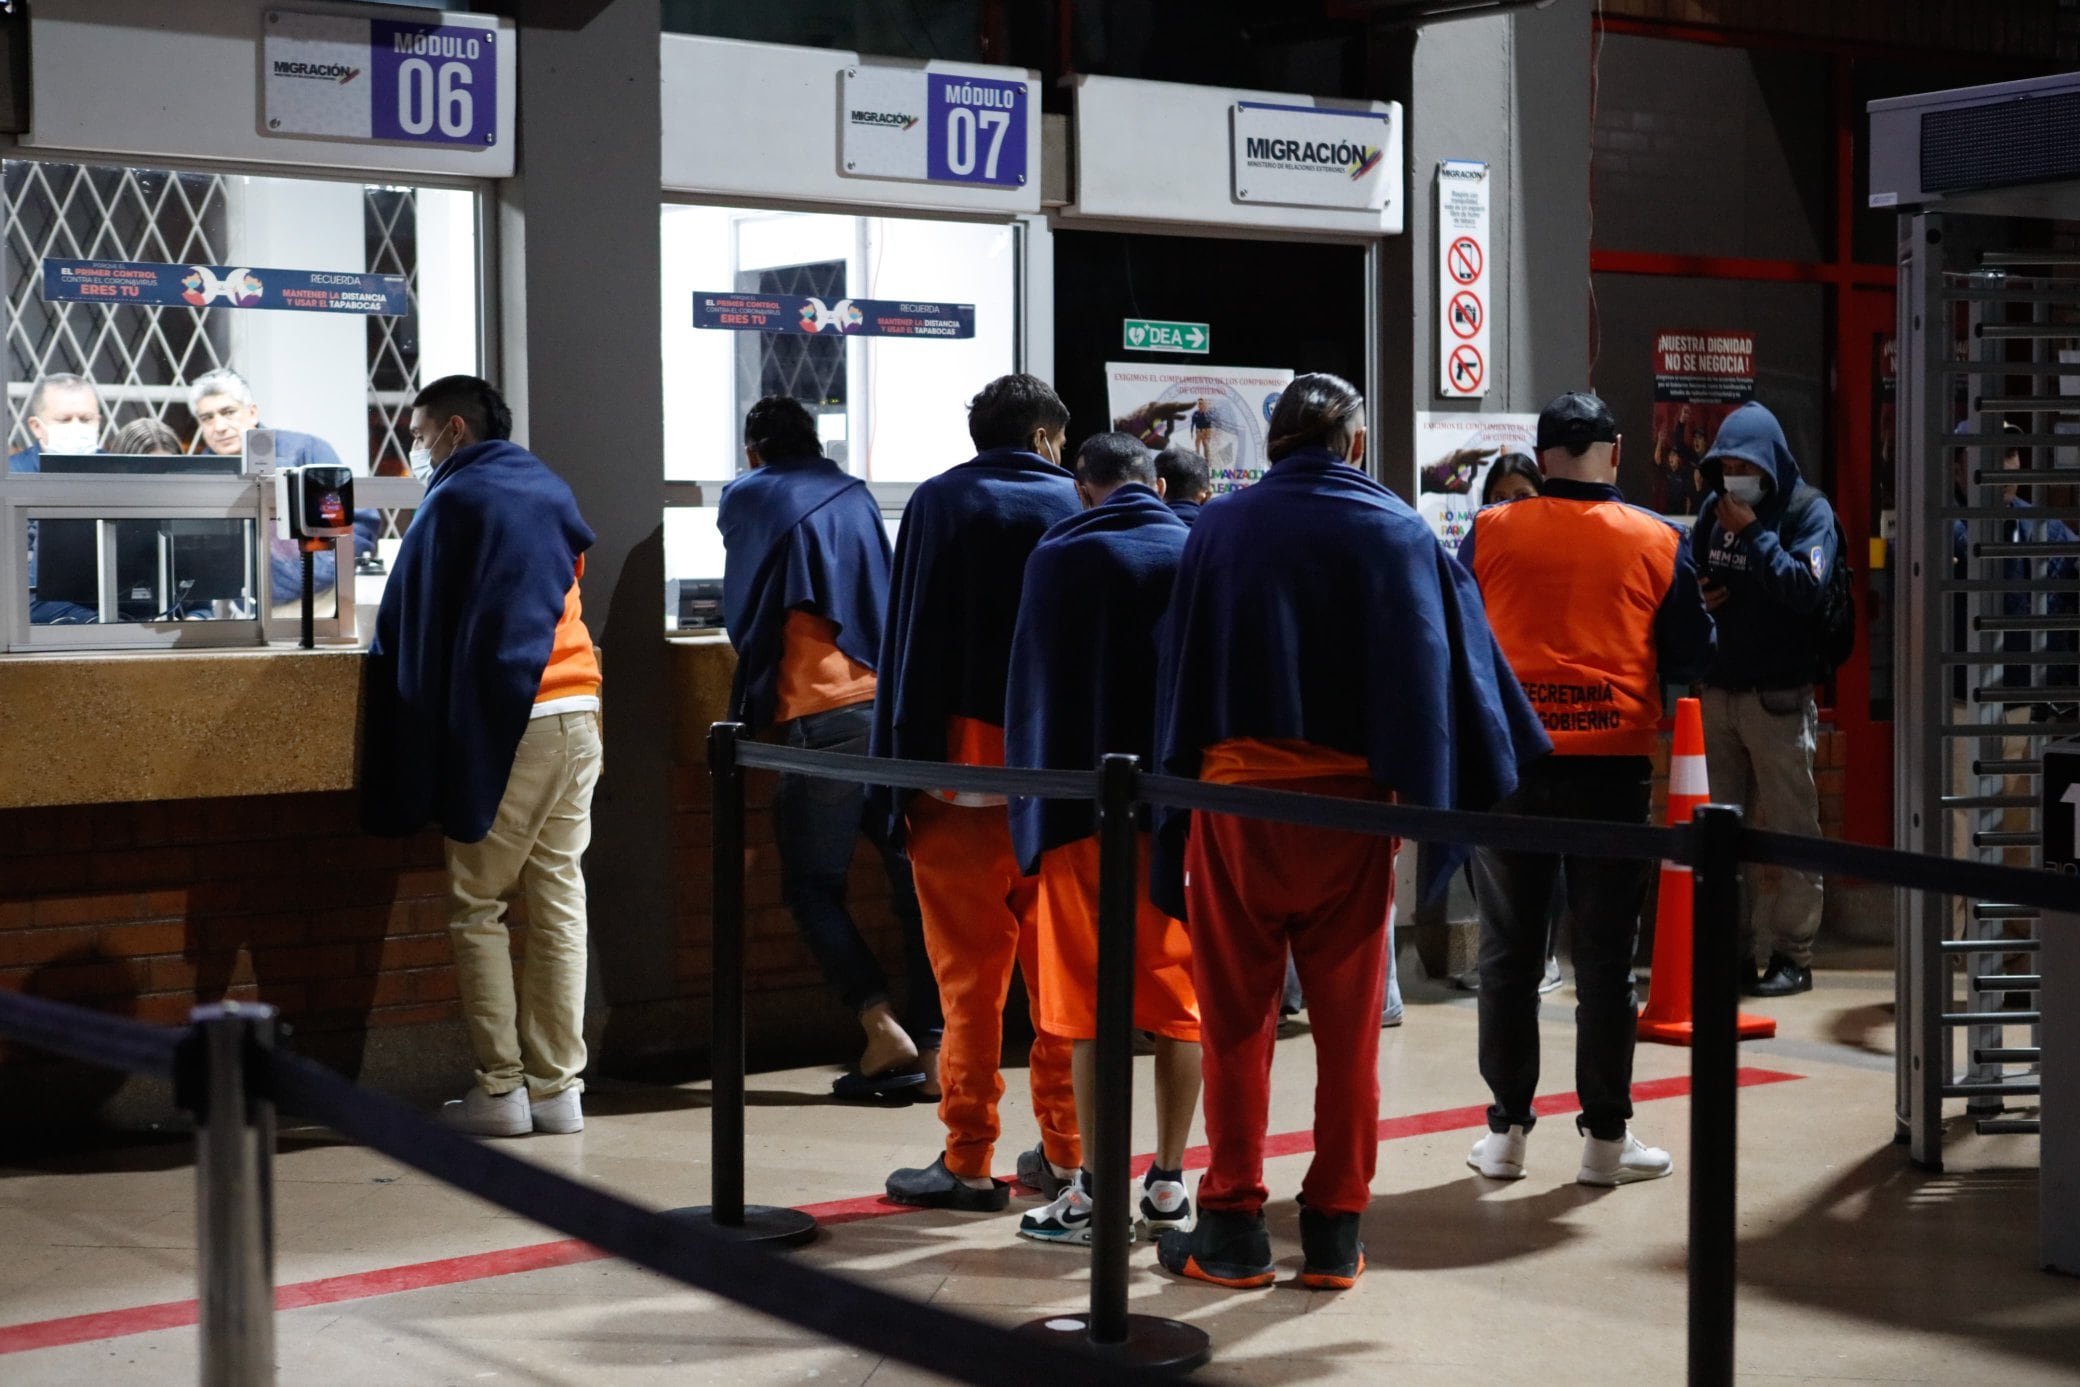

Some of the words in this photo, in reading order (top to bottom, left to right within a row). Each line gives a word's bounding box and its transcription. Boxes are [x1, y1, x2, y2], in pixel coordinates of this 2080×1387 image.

[393, 29, 479, 60] MÓDULO
[274, 61, 351, 78] MIGRACIÓN
[398, 58, 473, 138] 06
[945, 81, 1014, 109] MÓDULO
[851, 110, 912, 125] MIGRACIÓN
[947, 107, 1010, 179] 07
[1246, 137, 1366, 165] MIGRACIÓN
[60, 267, 74, 275] EL
[75, 268, 111, 277] PRIMER
[113, 269, 157, 279] CONTROL
[310, 273, 361, 286] RECUERDA
[61, 275, 92, 283] CONTRA
[104, 277, 158, 287] CORONAVIRUS
[80, 284, 117, 296] ERES
[282, 288, 327, 298] MANTENER
[329, 290, 340, 299] LA
[341, 291, 387, 302] DISTANCIA
[287, 298, 293, 306] Y
[294, 298, 317, 307] USAR
[318, 299, 328, 308] EL
[328, 300, 381, 310] TAPABOCAS
[716, 299, 745, 307] PRIMER
[746, 301, 781, 309] CONTROL
[900, 304, 940, 314] RECUERDA
[720, 314, 750, 323] ERES
[878, 317, 914, 326] MANTENER
[915, 318, 924, 326] LA
[924, 319, 961, 328] DISTANCIA
[913, 327, 956, 336] TAPABOCAS
[1150, 327, 1183, 345] DEA
[1658, 334, 1705, 353] ¡NUESTRA
[1707, 336, 1752, 354] DIGNIDAD
[1665, 353, 1680, 371] NO
[1683, 354, 1696, 371] SE
[1114, 373, 1149, 382] EXIGIMOS
[1149, 374, 1158, 382] EL
[1159, 374, 1214, 384] CUMPLIMIENTO
[1225, 377, 1238, 385] LOS
[1440, 511, 1453, 521] NO
[1441, 525, 1464, 535] PARA
[1540, 710, 1620, 731] GOBIERNO
